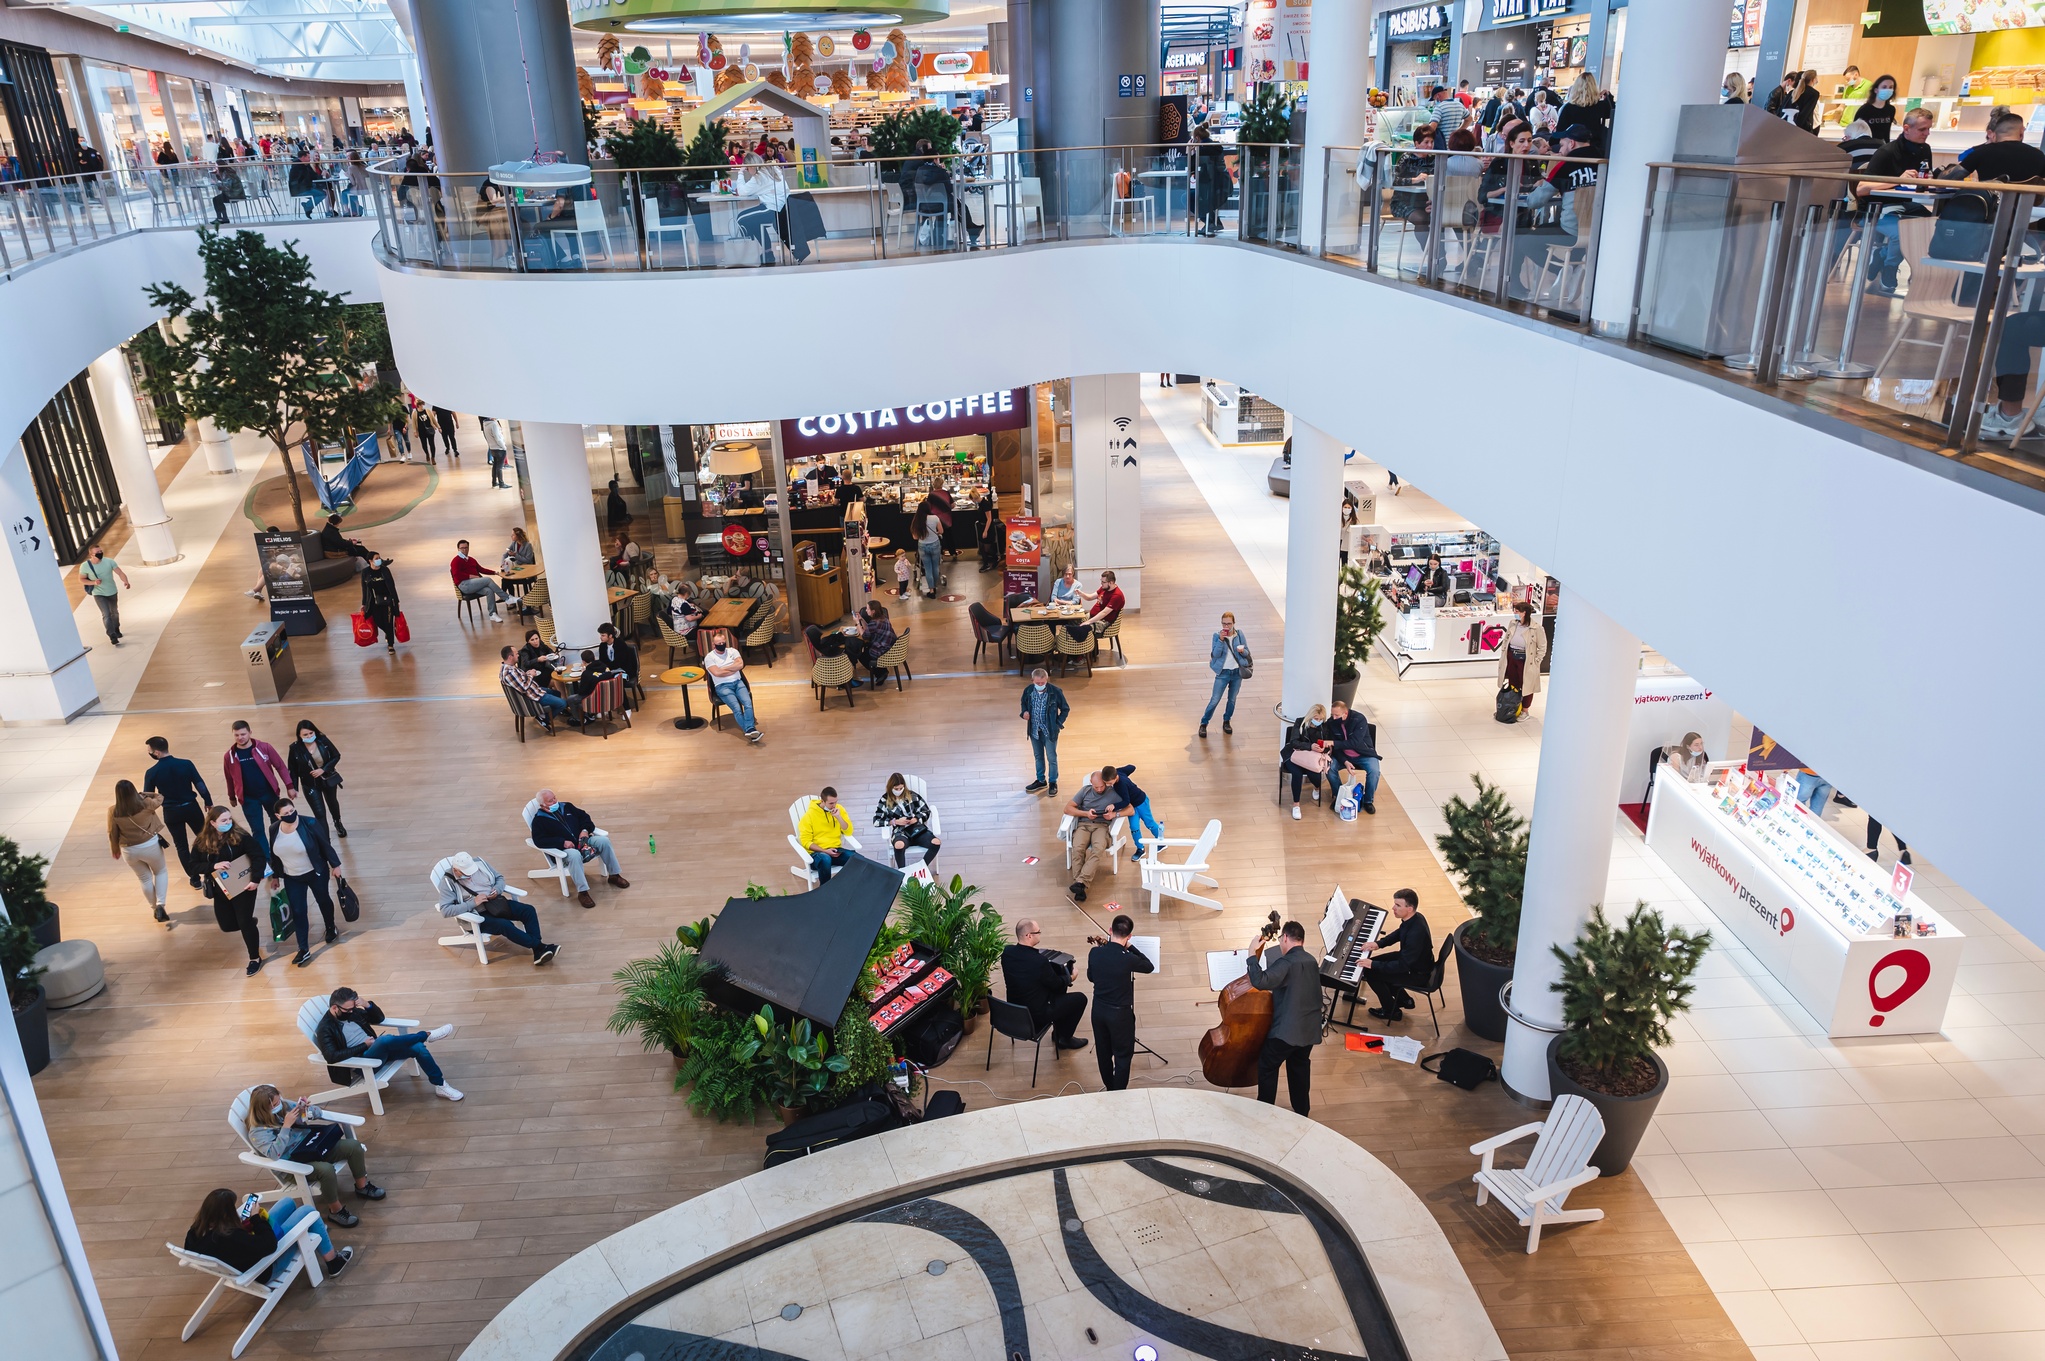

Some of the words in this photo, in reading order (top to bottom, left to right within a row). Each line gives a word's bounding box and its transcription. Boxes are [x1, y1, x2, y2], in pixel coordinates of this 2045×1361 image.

[1390, 7, 1429, 36] PASIBUS
[1165, 54, 1185, 68] RGER
[1185, 52, 1206, 67] KING
[798, 408, 898, 438] COSTA
[906, 389, 1014, 424] COFFEE
[719, 428, 754, 438] COSTA
[1634, 694, 1672, 704] yjątkowy
[1672, 692, 1704, 702] prezent
[1691, 837, 1740, 893] wyjątkowy
[1739, 885, 1779, 930] prezent
[1896, 871, 1908, 892] 3
[279, 903, 290, 922] D
